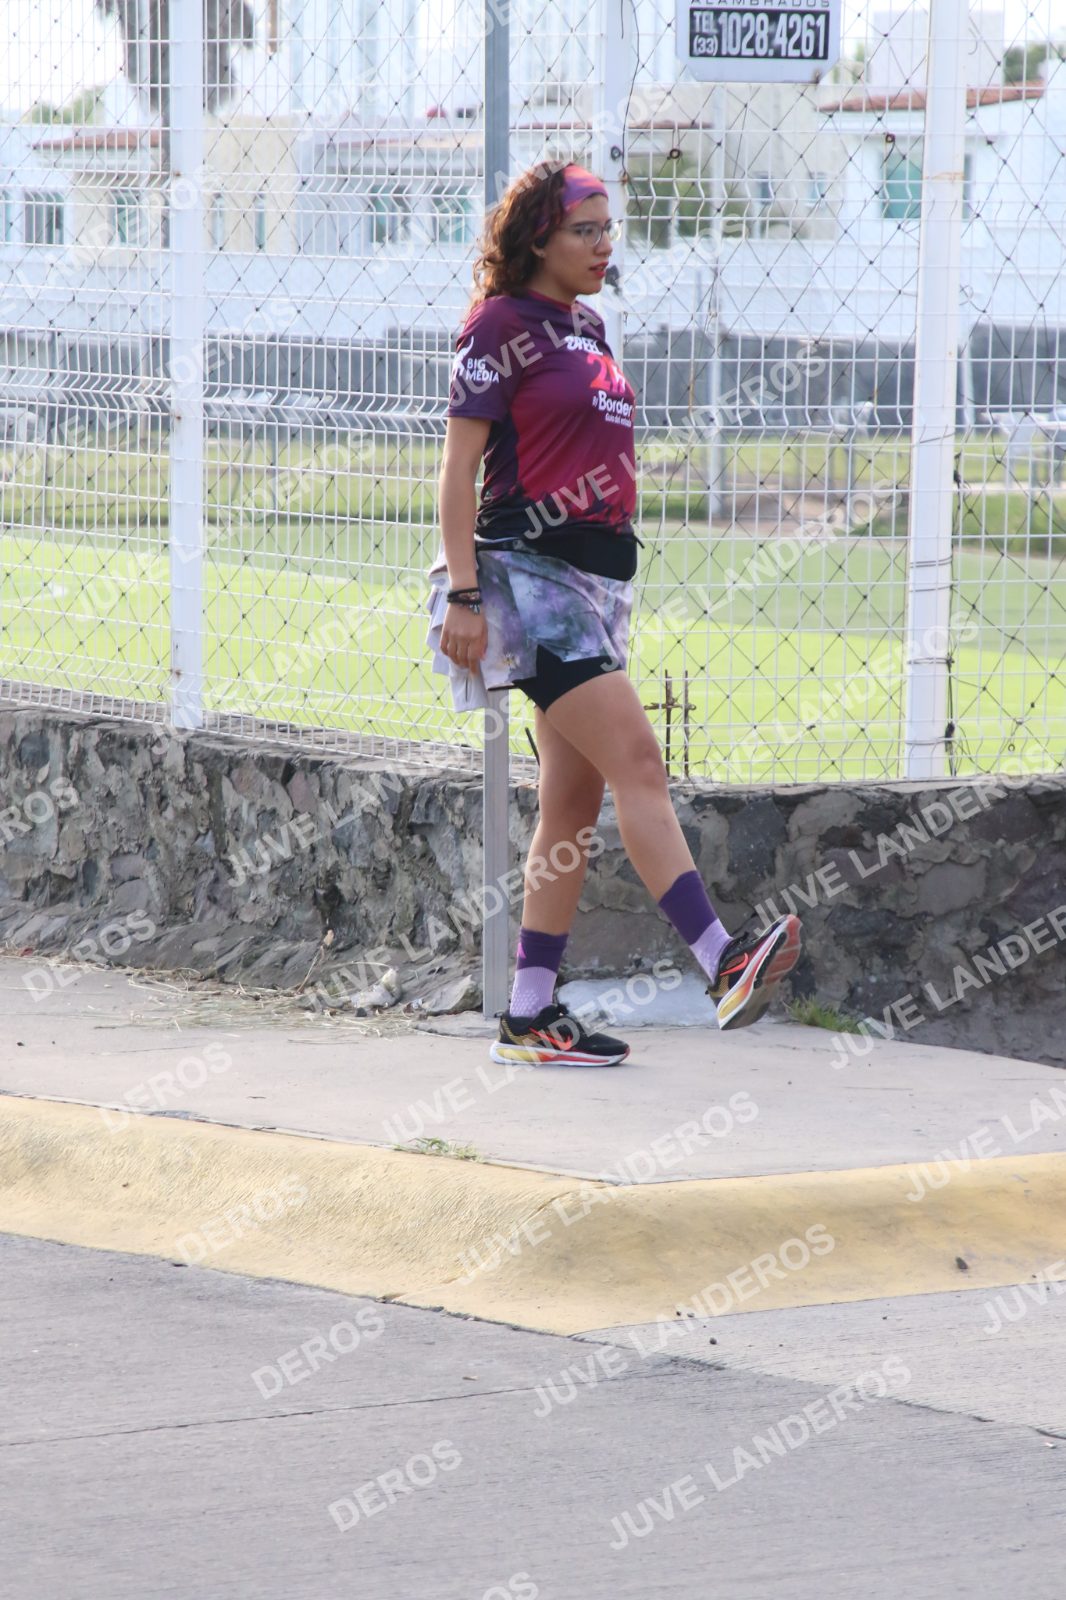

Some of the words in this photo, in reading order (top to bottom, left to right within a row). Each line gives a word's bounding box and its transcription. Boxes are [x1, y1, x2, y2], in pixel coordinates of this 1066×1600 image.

[718, 11, 826, 58] 1028.4261
[693, 35, 718, 56] (33)
[467, 357, 486, 370] BIG
[465, 369, 500, 383] MEDIA
[598, 390, 633, 418] Border
